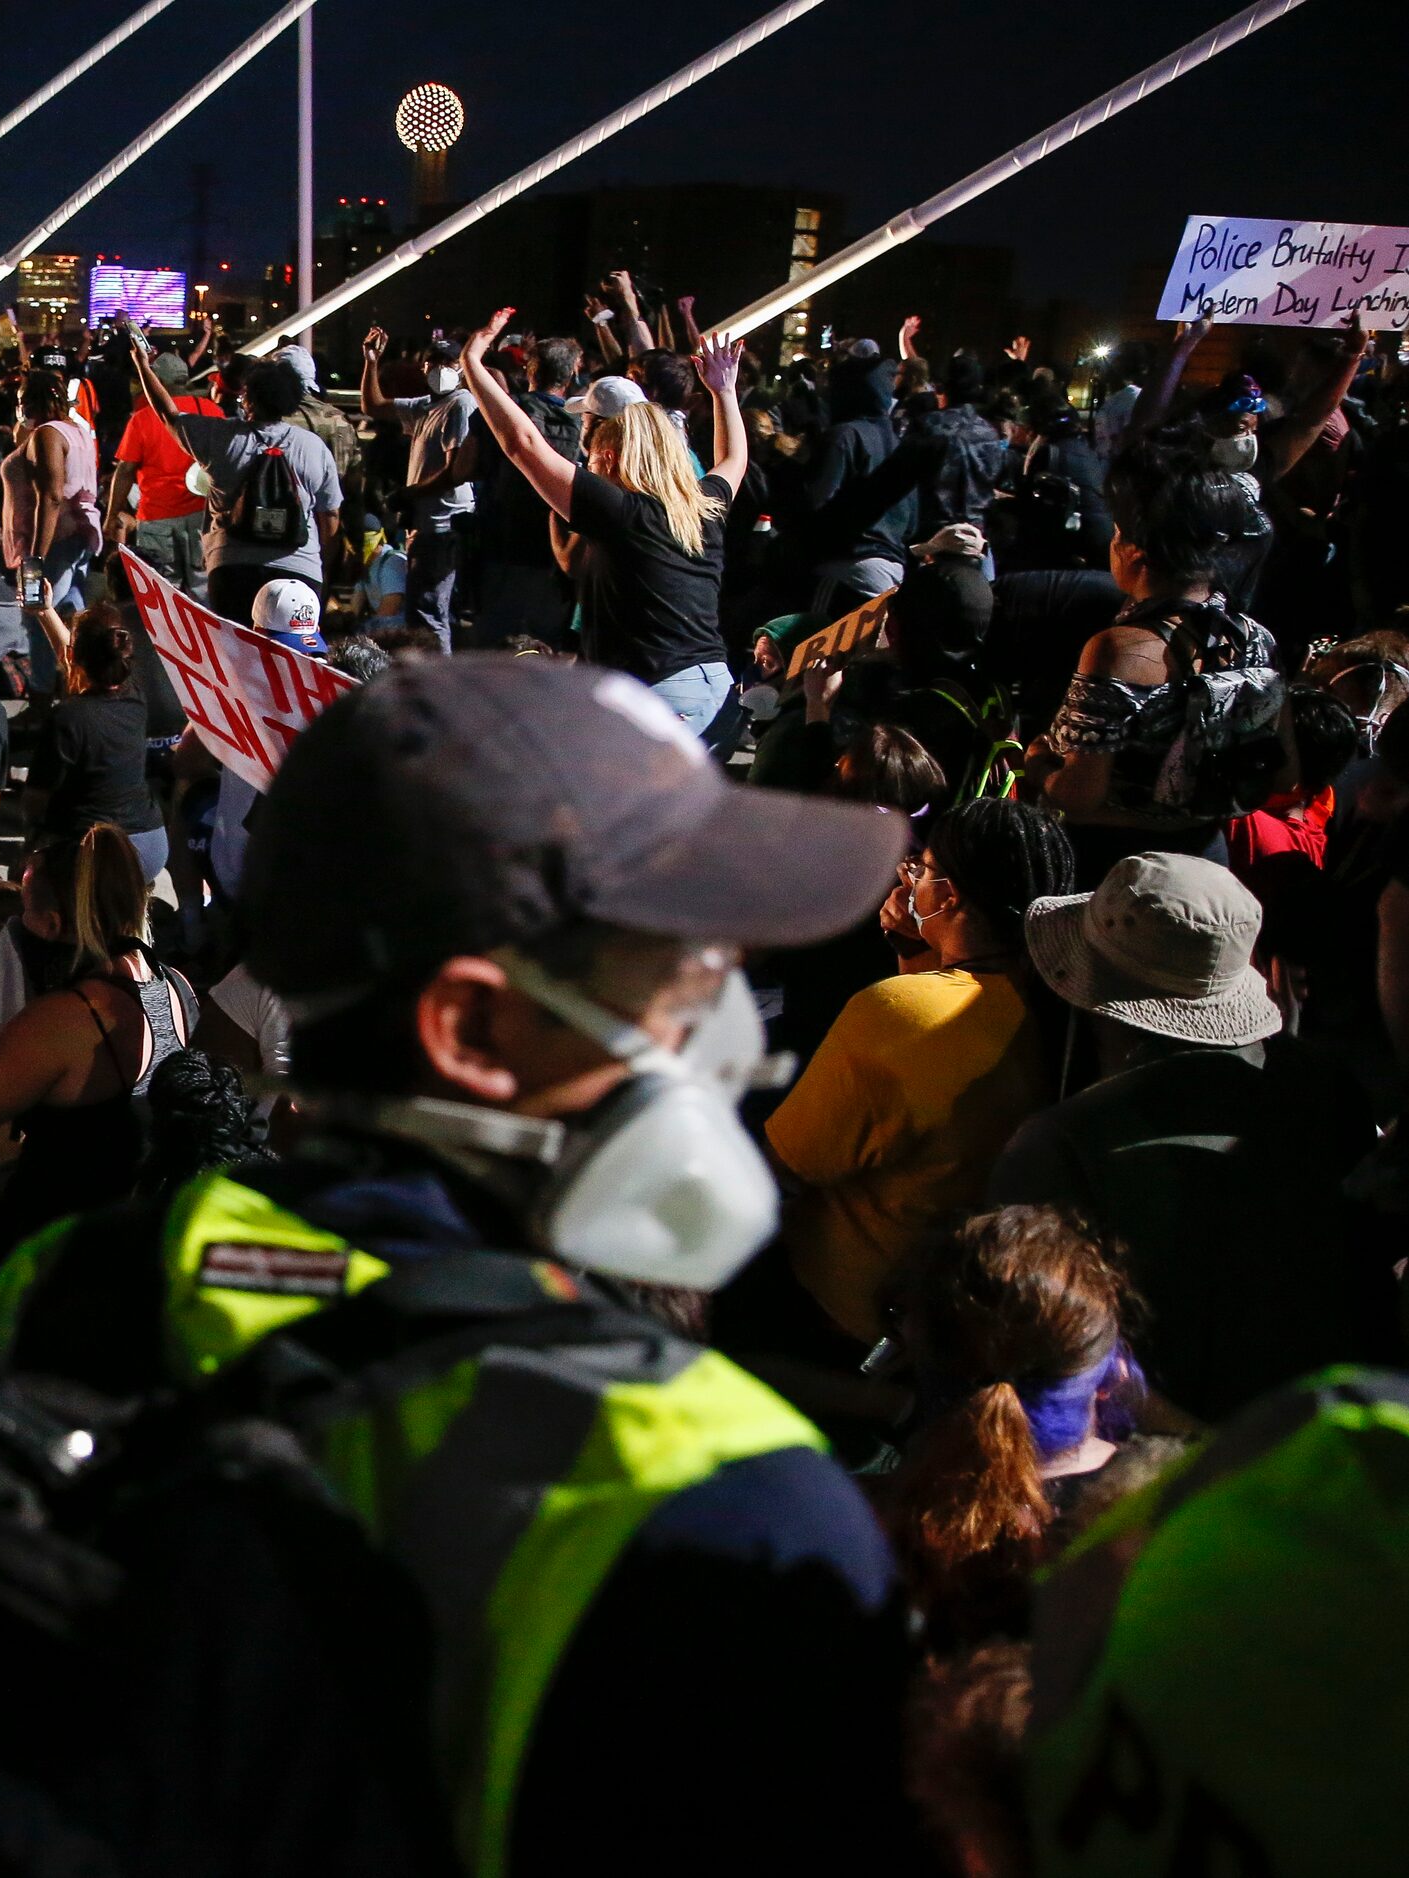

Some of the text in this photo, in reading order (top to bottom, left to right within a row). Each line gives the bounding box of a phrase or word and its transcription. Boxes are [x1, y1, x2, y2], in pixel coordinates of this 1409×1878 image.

[1188, 223, 1409, 284] Police Brutality I
[1179, 282, 1258, 315] Modern
[1272, 281, 1321, 325] Day
[120, 552, 230, 688] PUT
[154, 642, 278, 778] IN
